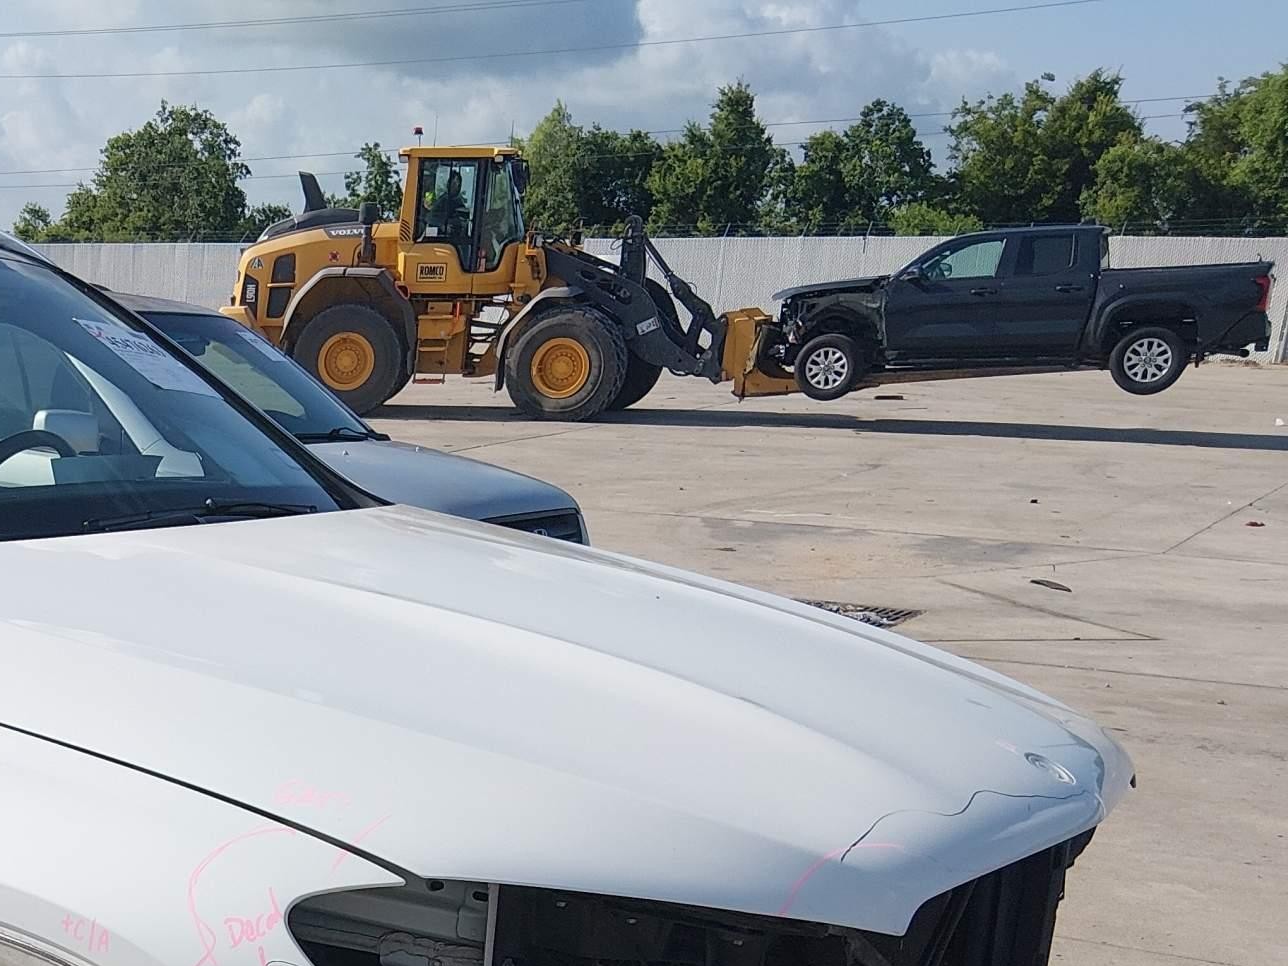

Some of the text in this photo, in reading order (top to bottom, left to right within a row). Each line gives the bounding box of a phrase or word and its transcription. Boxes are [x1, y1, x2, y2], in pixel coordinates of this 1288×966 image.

[329, 228, 364, 236] VOLV
[419, 265, 444, 276] ROMCO
[246, 284, 256, 303] L90H
